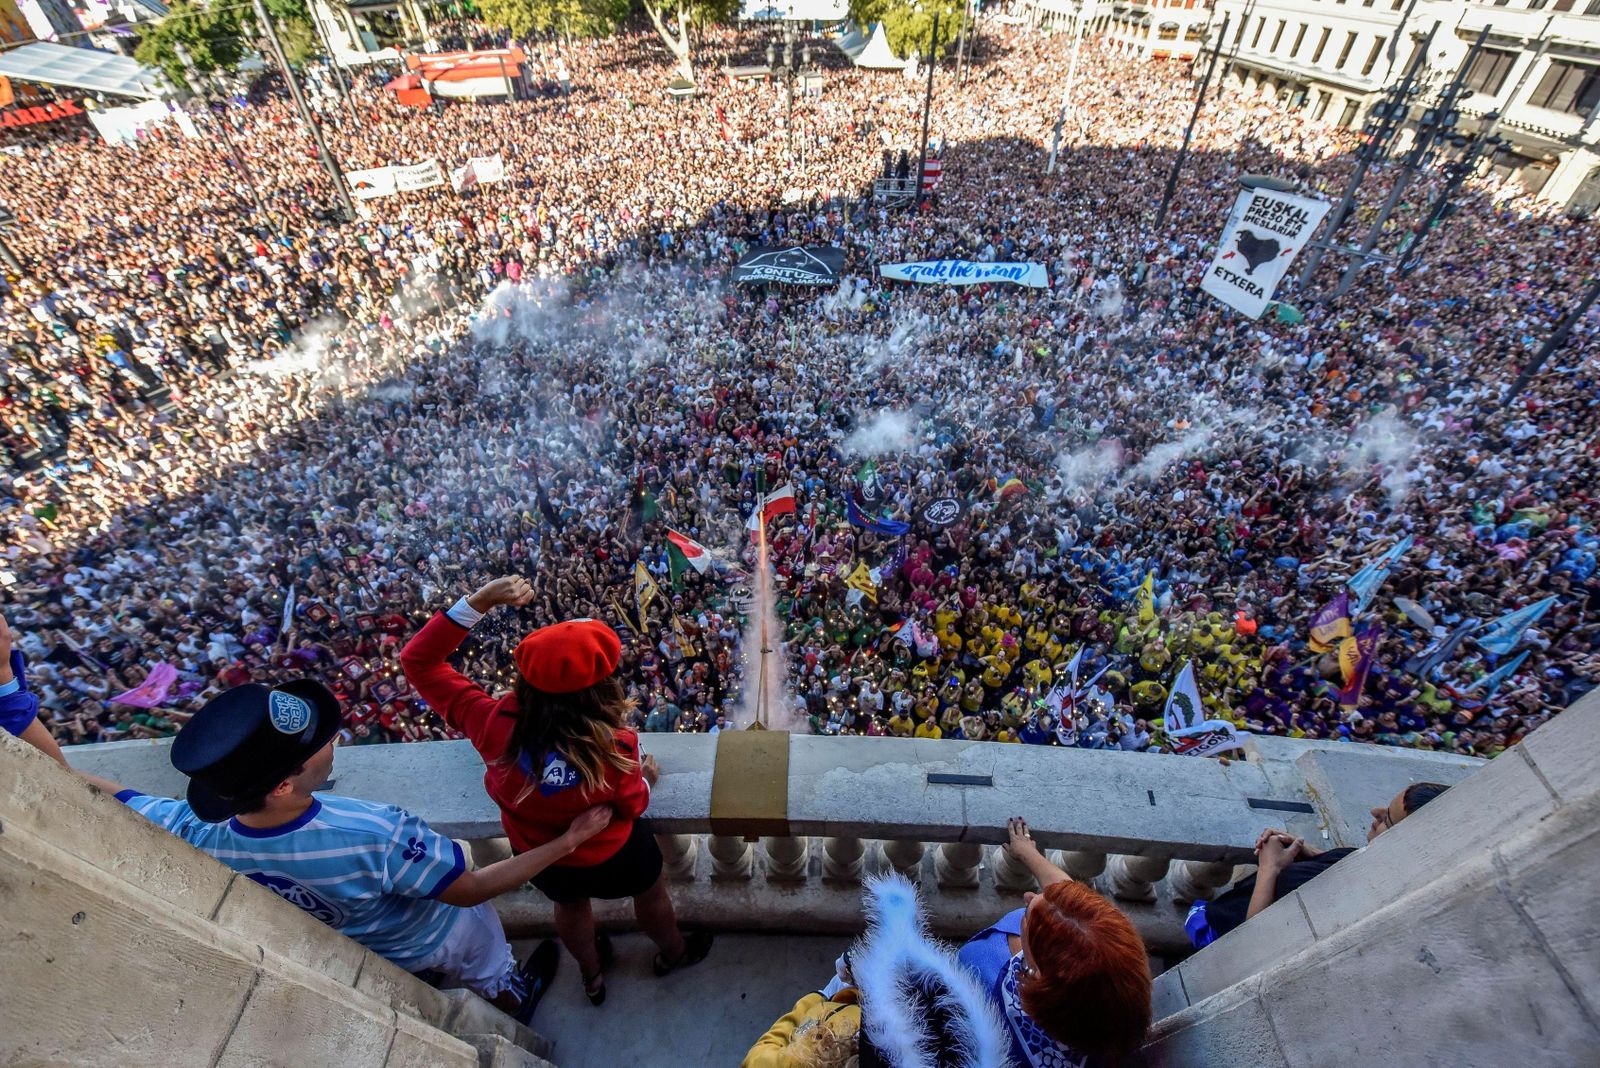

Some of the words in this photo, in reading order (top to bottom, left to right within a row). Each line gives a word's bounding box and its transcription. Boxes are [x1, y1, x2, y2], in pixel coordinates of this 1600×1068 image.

[0, 98, 83, 128] ARRAK
[1247, 207, 1282, 223] PRESO
[1285, 217, 1303, 232] ETA
[1251, 195, 1310, 224] EUSKAL
[1213, 266, 1265, 299] ETXERA
